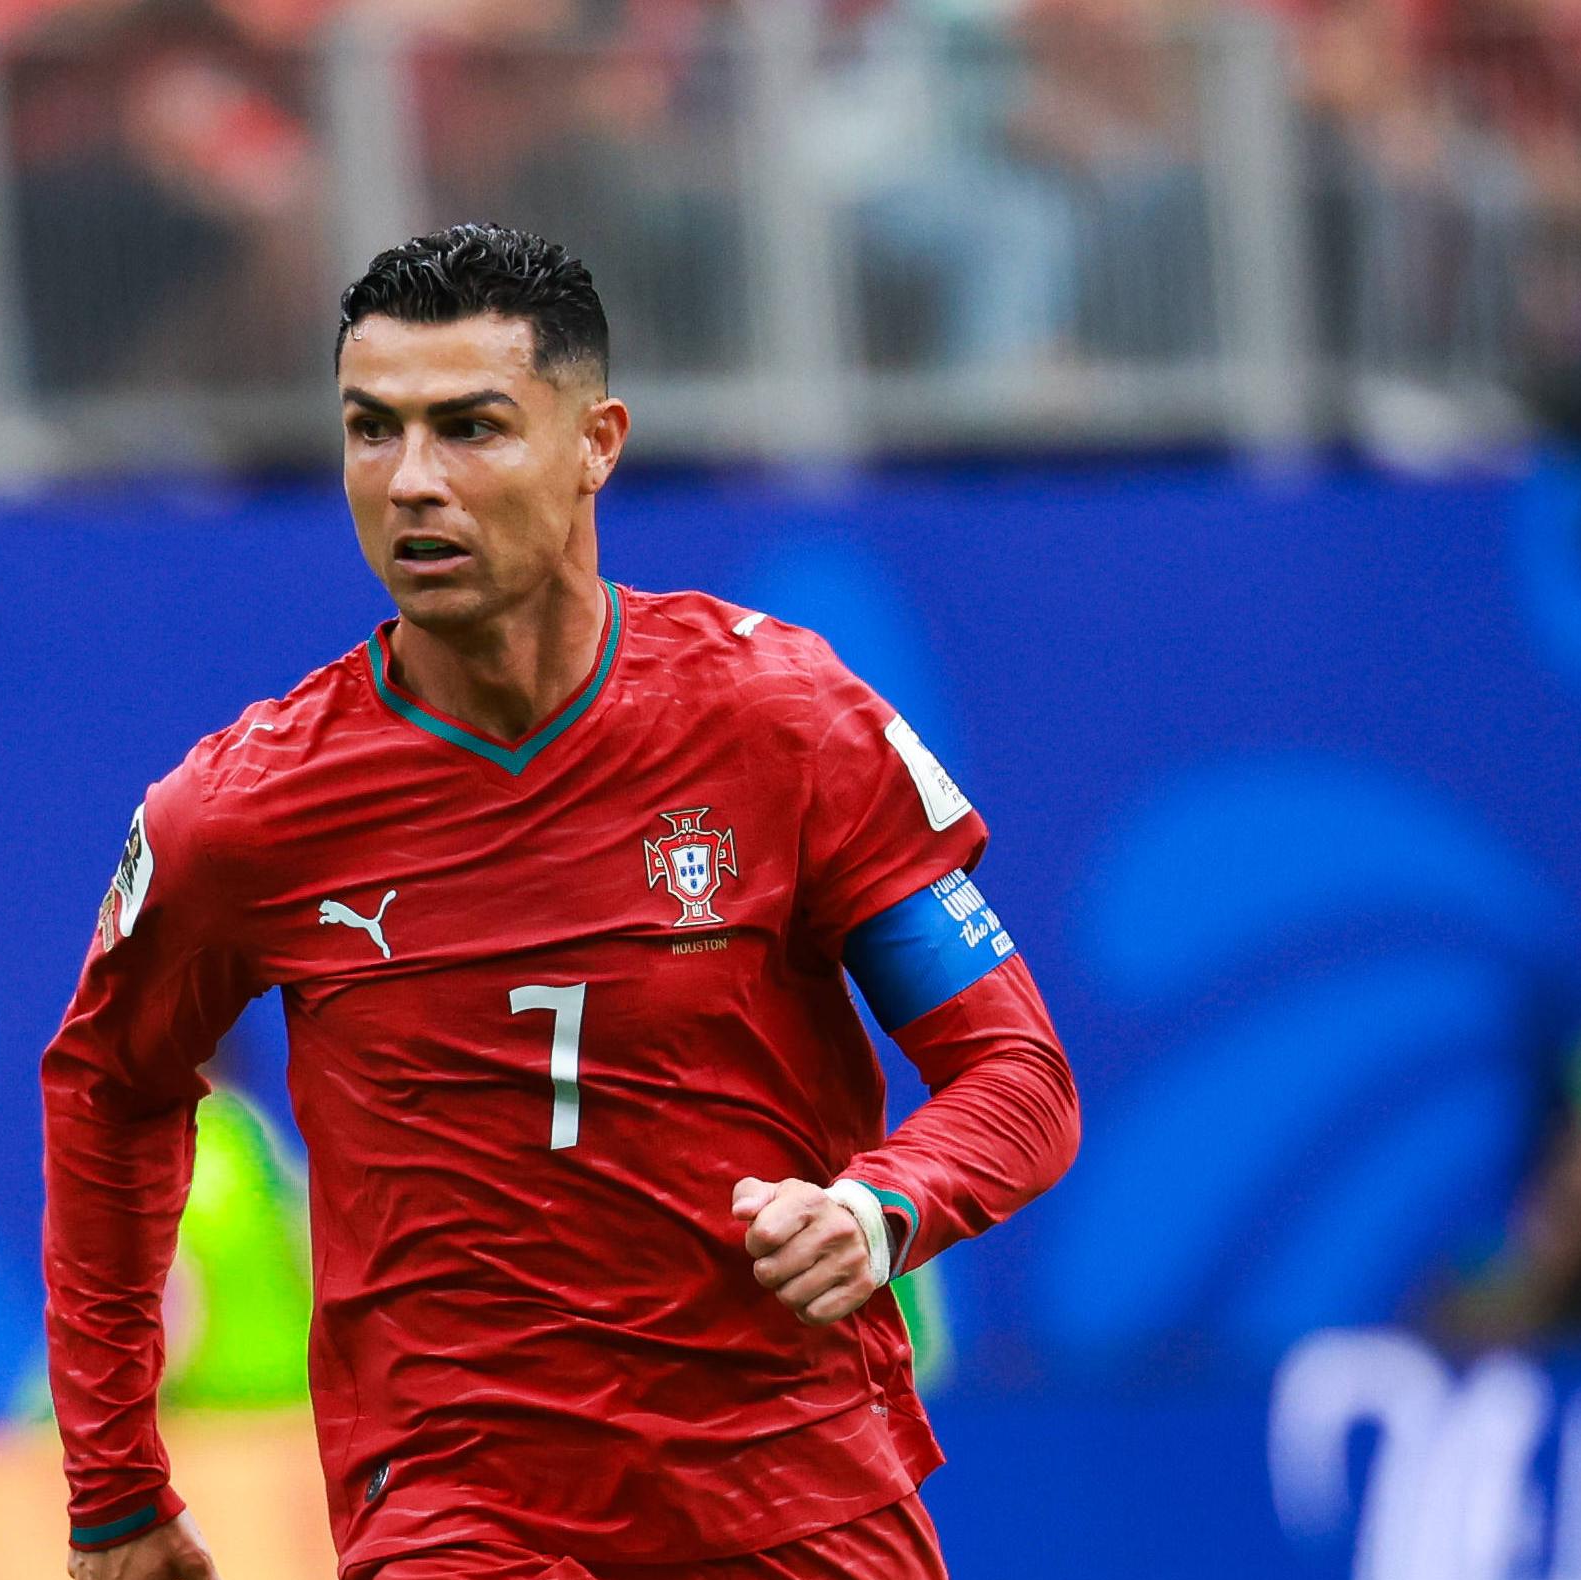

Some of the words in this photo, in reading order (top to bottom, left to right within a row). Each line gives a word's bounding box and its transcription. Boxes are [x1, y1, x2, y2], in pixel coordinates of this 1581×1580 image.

[942, 880, 986, 921] UNIT
[672, 938, 728, 955] HOUSTON
[959, 919, 988, 948] the
[509, 982, 587, 1150] 7
